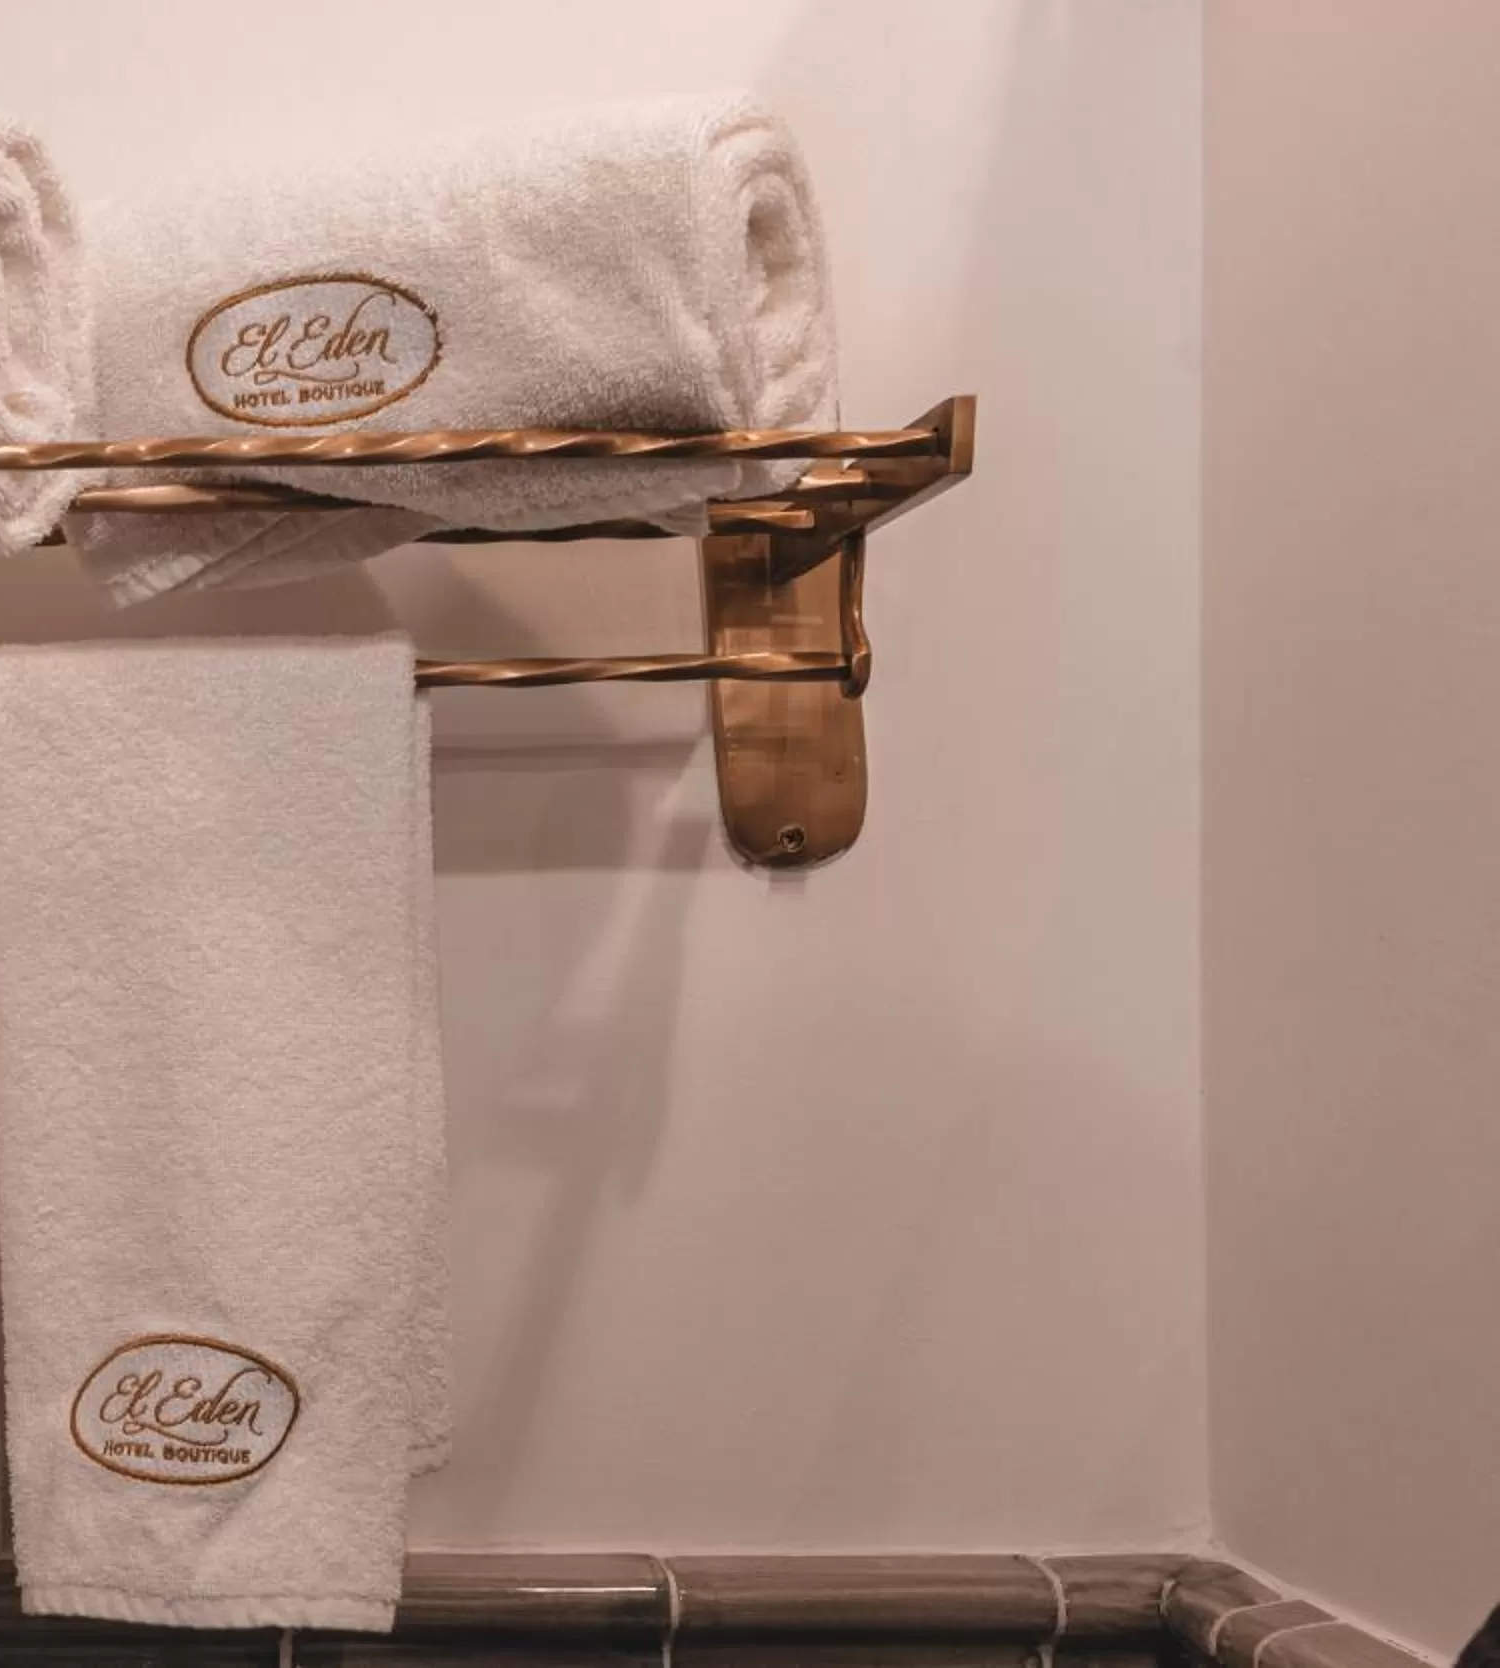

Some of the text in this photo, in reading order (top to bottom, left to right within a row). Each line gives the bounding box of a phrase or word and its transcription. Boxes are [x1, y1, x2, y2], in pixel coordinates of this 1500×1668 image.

[220, 291, 398, 382] El Eden
[233, 380, 385, 409] HOTEL BOUTIQUE
[100, 1367, 272, 1437] El Eden
[103, 1440, 253, 1465] HOTEL BOUTIQUE
